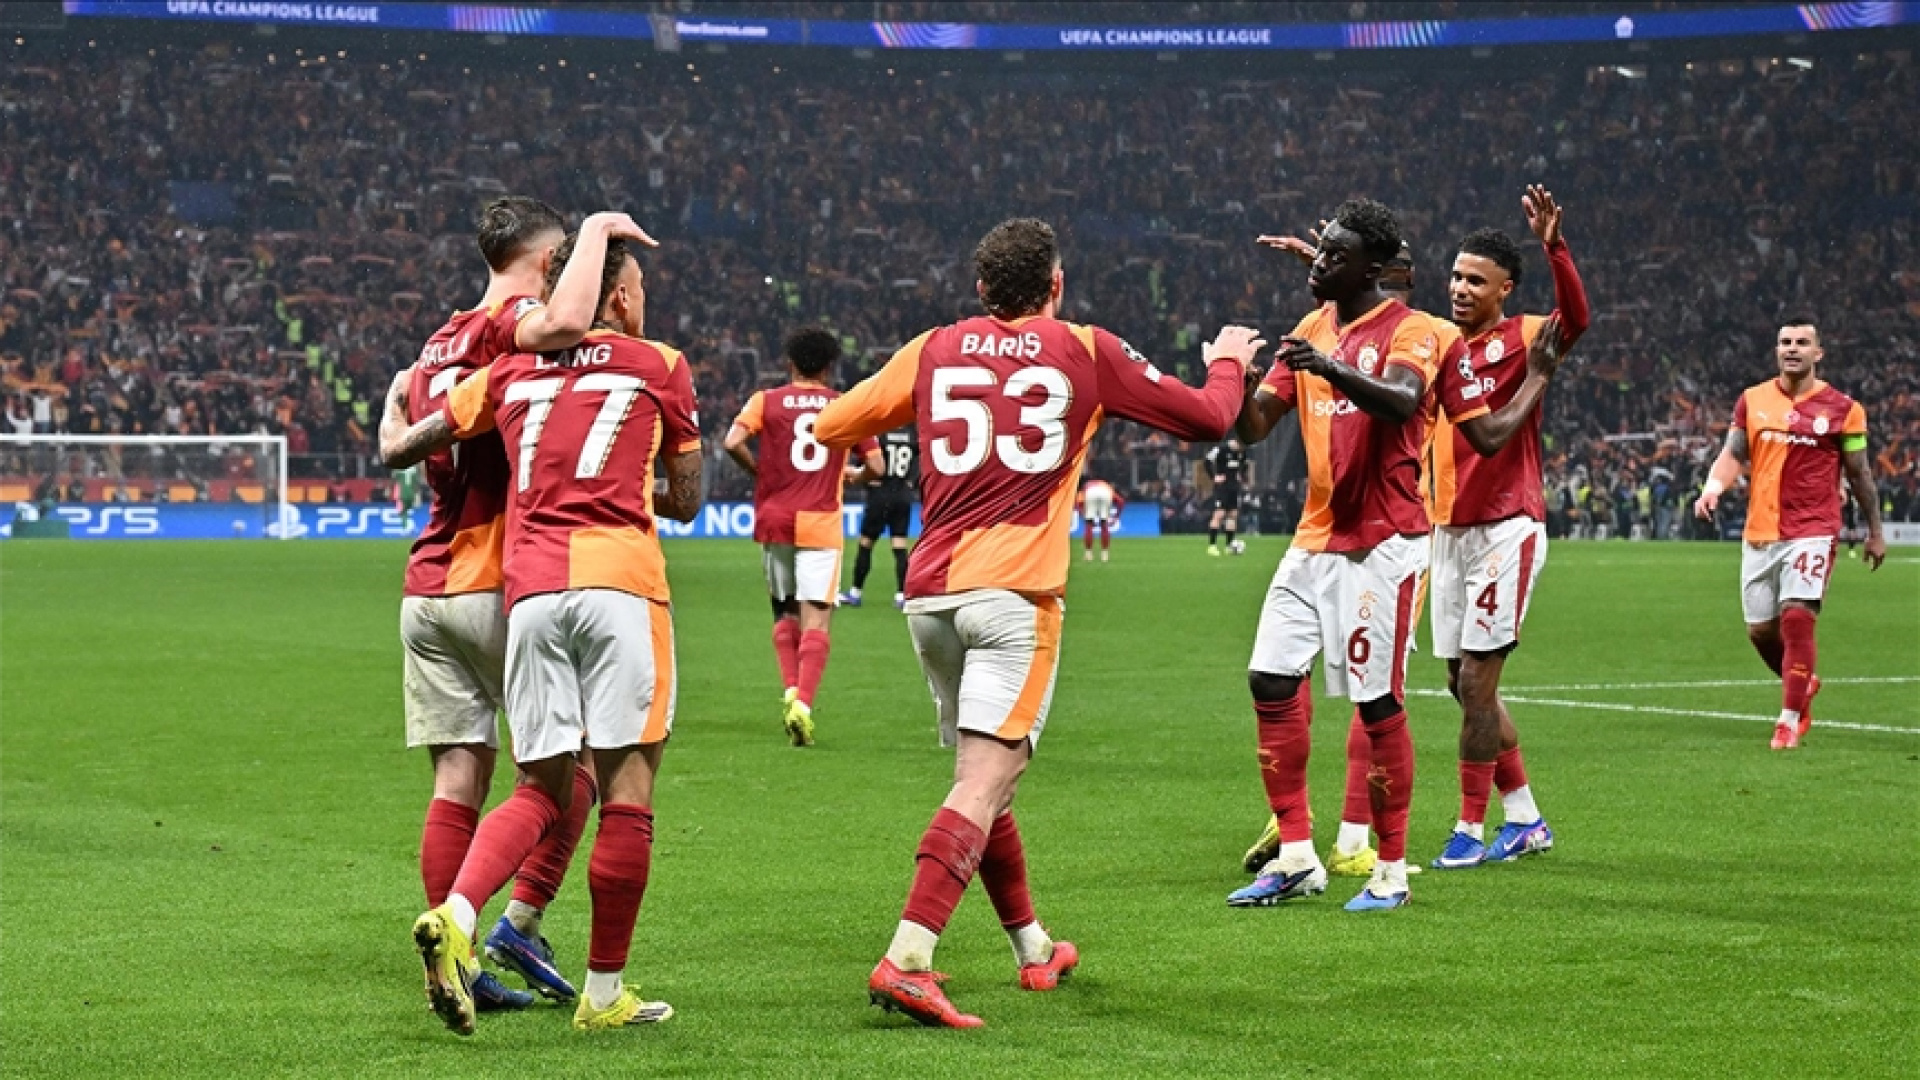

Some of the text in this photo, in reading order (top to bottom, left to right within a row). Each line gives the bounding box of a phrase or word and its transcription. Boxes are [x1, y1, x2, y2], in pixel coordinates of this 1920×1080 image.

[166, 0, 379, 22] UEFA CHAMPIONS LEAGUE
[1060, 29, 1271, 45] UEFA CHAMPIONS LEAGUE
[534, 343, 613, 370] LANG
[782, 395, 828, 409] G.SAR
[1313, 400, 1358, 416] SOCA
[504, 372, 646, 494] 77
[930, 365, 1074, 476] 53
[789, 412, 829, 472] 8
[885, 444, 912, 478] 18
[57, 506, 159, 534] PS5
[316, 506, 416, 534] PS5
[1793, 551, 1825, 579] 42
[1475, 581, 1499, 616] 4
[1347, 626, 1370, 664] 6
